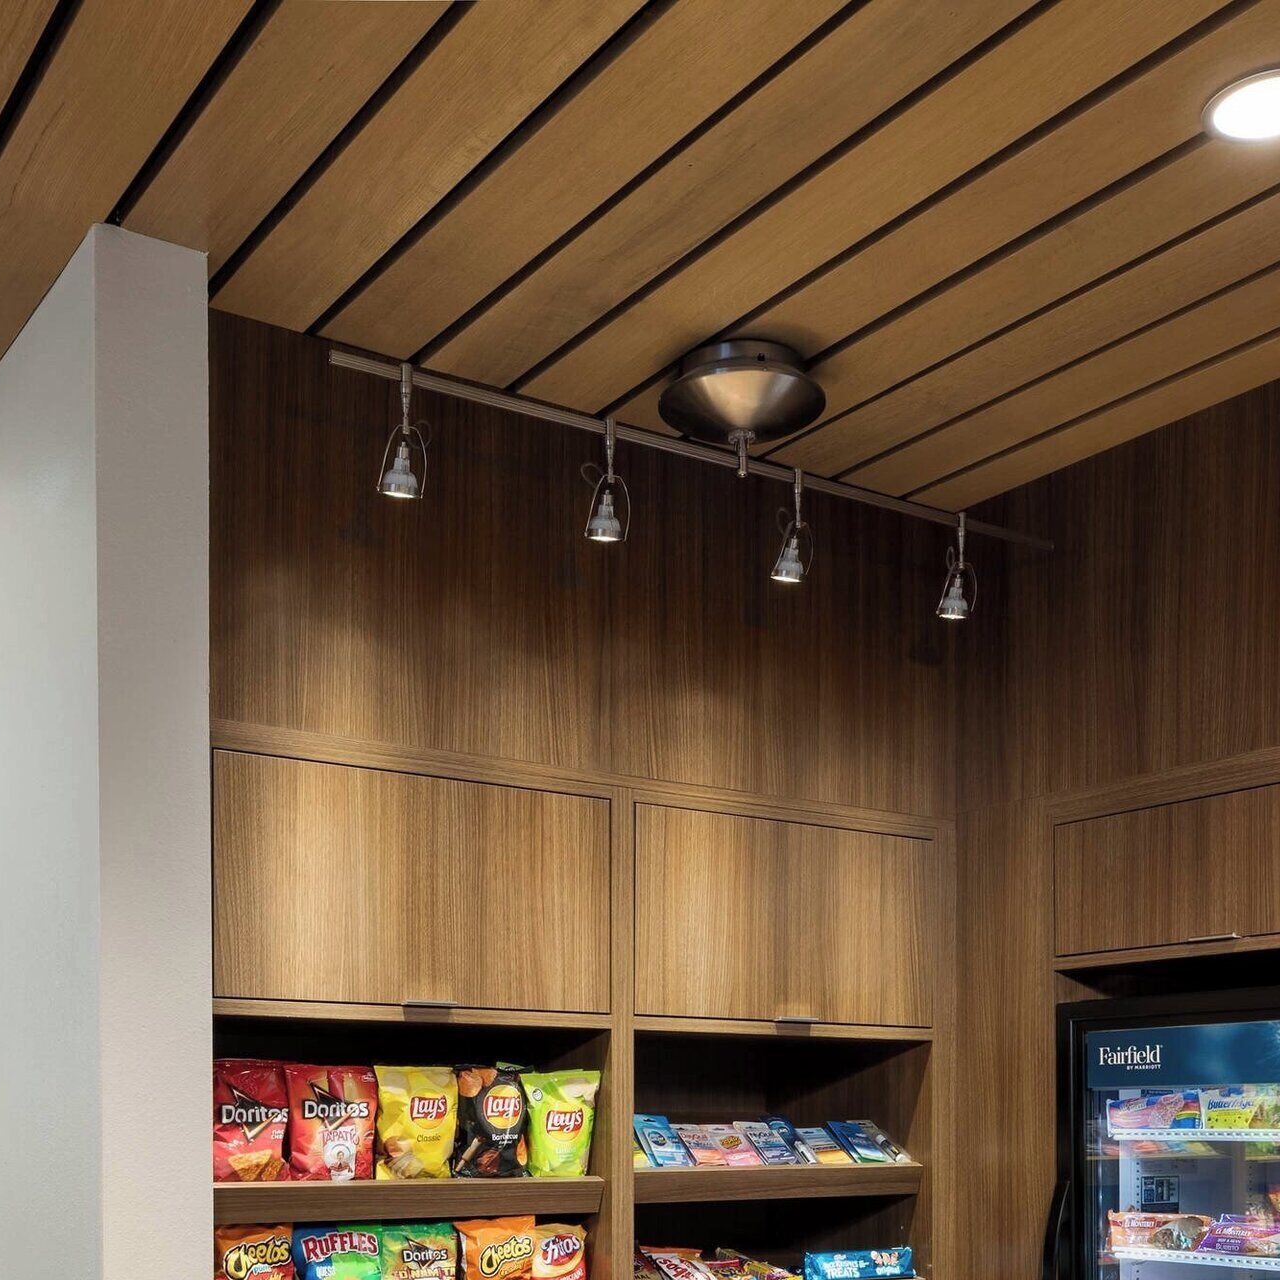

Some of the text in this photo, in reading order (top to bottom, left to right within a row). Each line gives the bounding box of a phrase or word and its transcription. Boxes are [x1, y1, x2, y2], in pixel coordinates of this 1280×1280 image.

[1099, 1044, 1161, 1065] Fairfield
[221, 1104, 289, 1124] Doritos
[304, 1100, 370, 1118] Doritos
[412, 1095, 446, 1119] Lay's
[416, 1134, 441, 1143] Classic
[492, 1132, 519, 1141] Barbecue
[301, 1231, 380, 1263] RUFFLES
[403, 1249, 448, 1264] Doritos
[481, 1237, 533, 1277] Cheetos
[540, 1234, 582, 1265] Fritos
